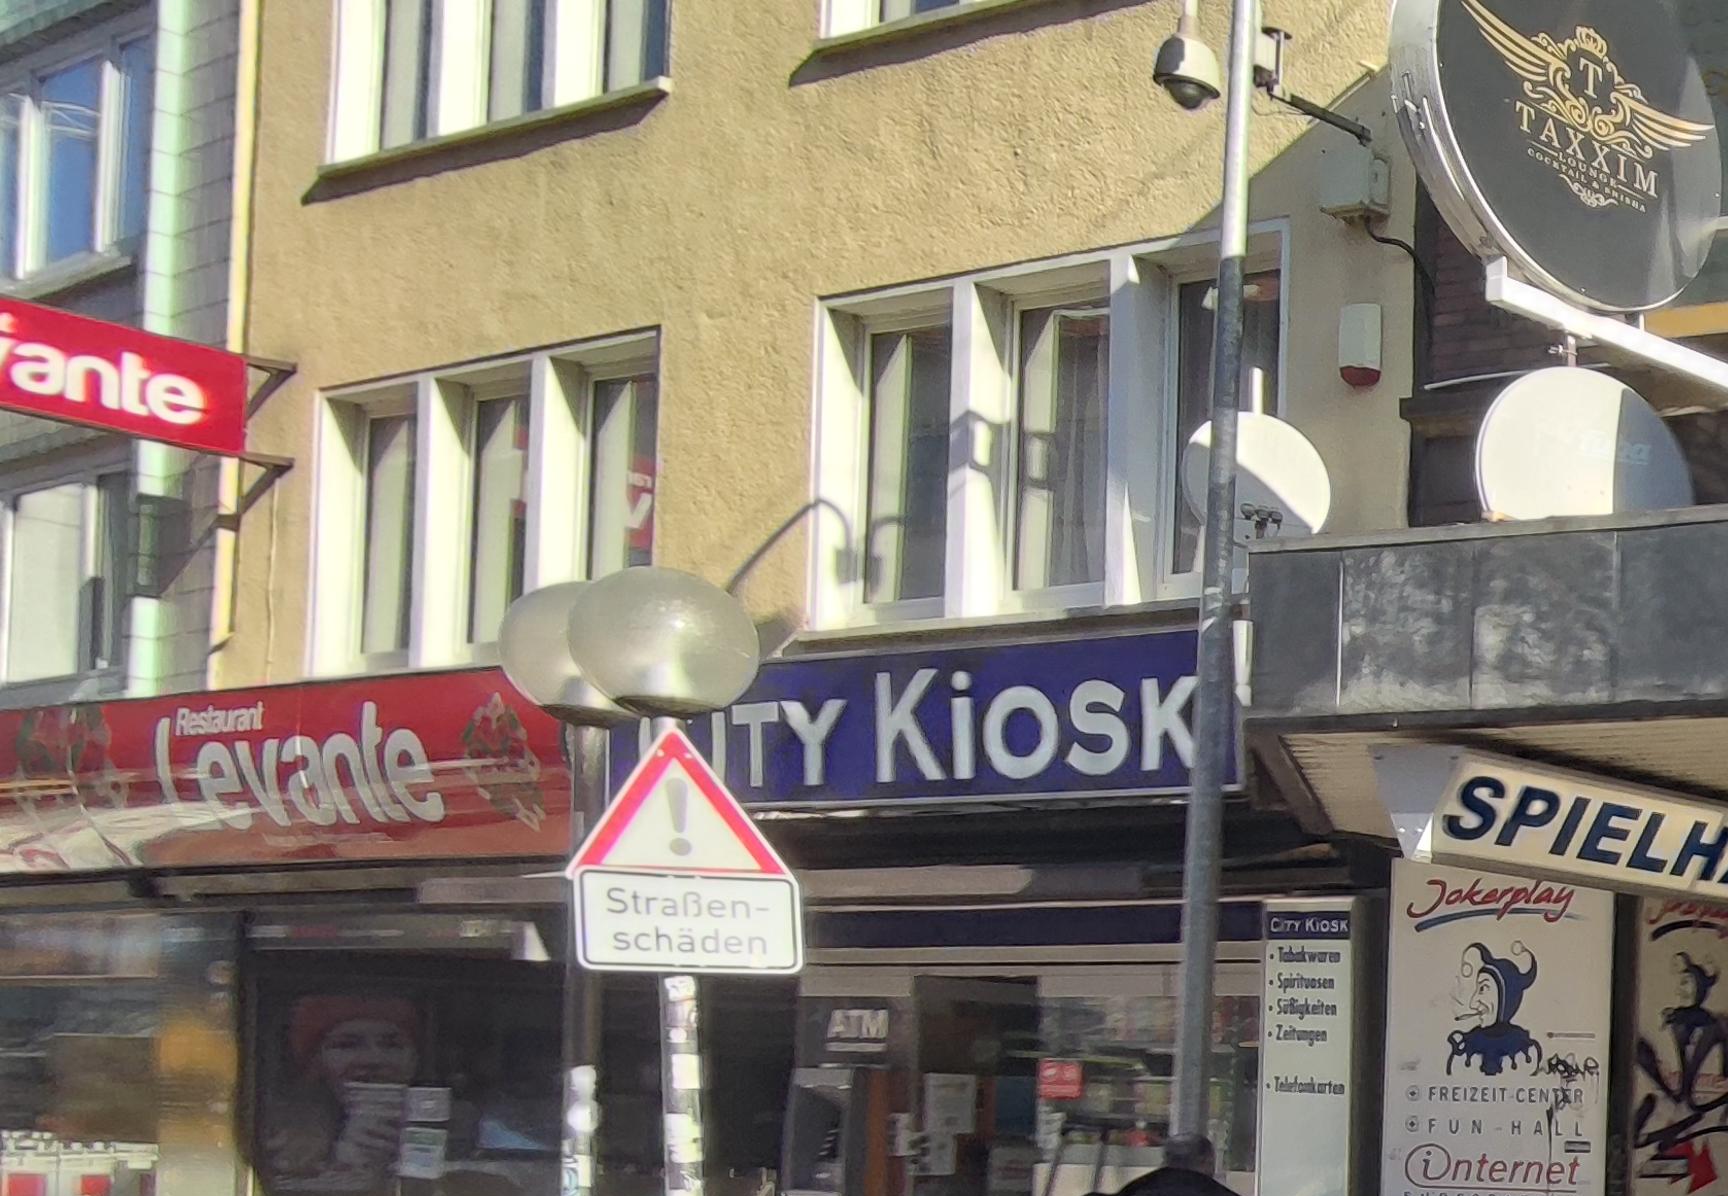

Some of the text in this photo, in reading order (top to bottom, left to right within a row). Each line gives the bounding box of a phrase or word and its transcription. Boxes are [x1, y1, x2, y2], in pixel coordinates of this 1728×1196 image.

[1515, 100, 1659, 198] TAXXIM
[1527, 148, 1588, 184] COCKTAIL
[1558, 151, 1619, 188] LOUNGE
[0, 334, 206, 425] ante
[175, 700, 264, 736] Restaurant
[638, 698, 847, 788] ITY
[155, 700, 446, 830] Levante
[605, 887, 771, 919] Straßen-
[1406, 877, 1577, 923] Jokerplay
[612, 925, 768, 956] schäden
[1276, 972, 1335, 993] Spirituosen
[827, 1008, 890, 1039] ATM
[1276, 997, 1338, 1020] Süßigkeiten
[1275, 1024, 1328, 1046] Zeitungen
